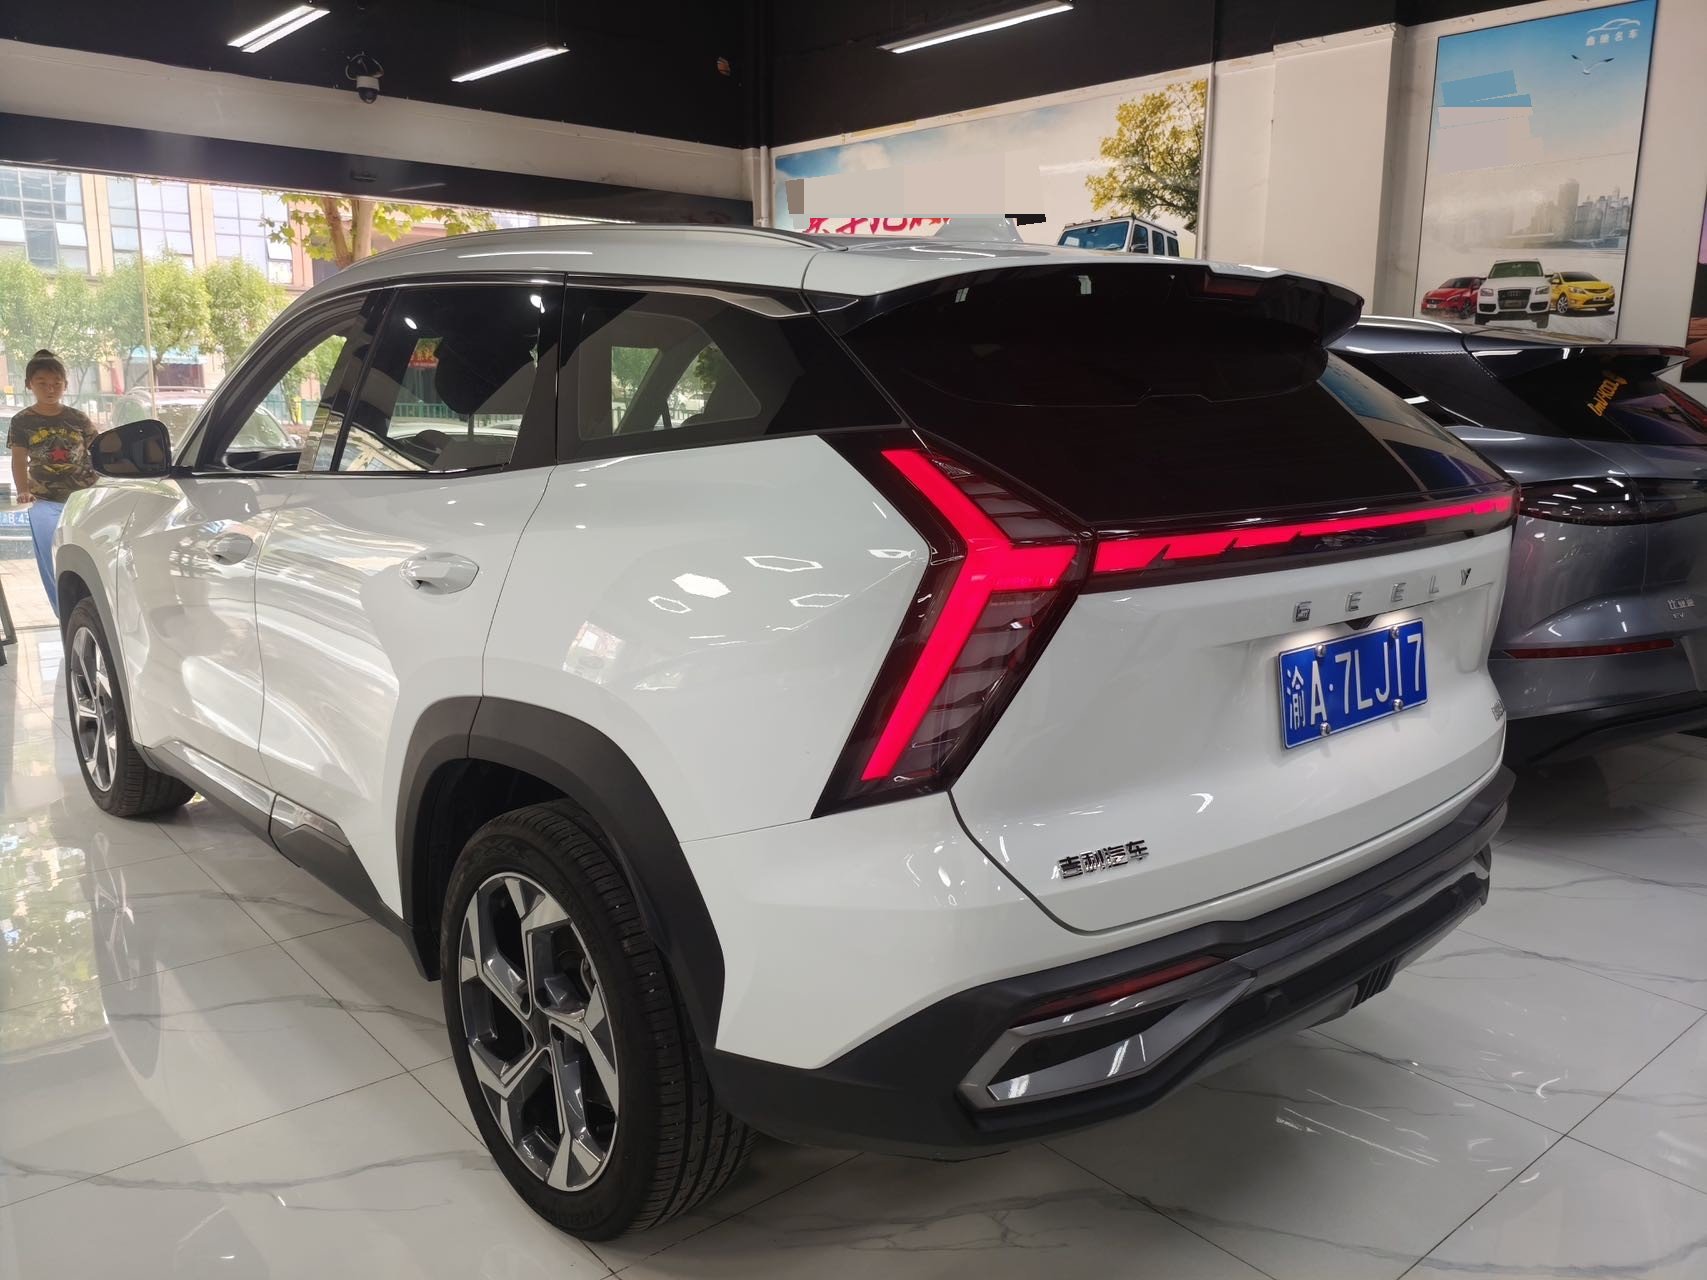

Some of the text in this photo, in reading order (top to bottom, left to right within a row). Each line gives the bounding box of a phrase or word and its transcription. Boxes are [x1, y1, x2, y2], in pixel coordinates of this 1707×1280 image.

[1293, 567, 1472, 623] GEELY
[1059, 839, 1150, 879] 吉利汽车
